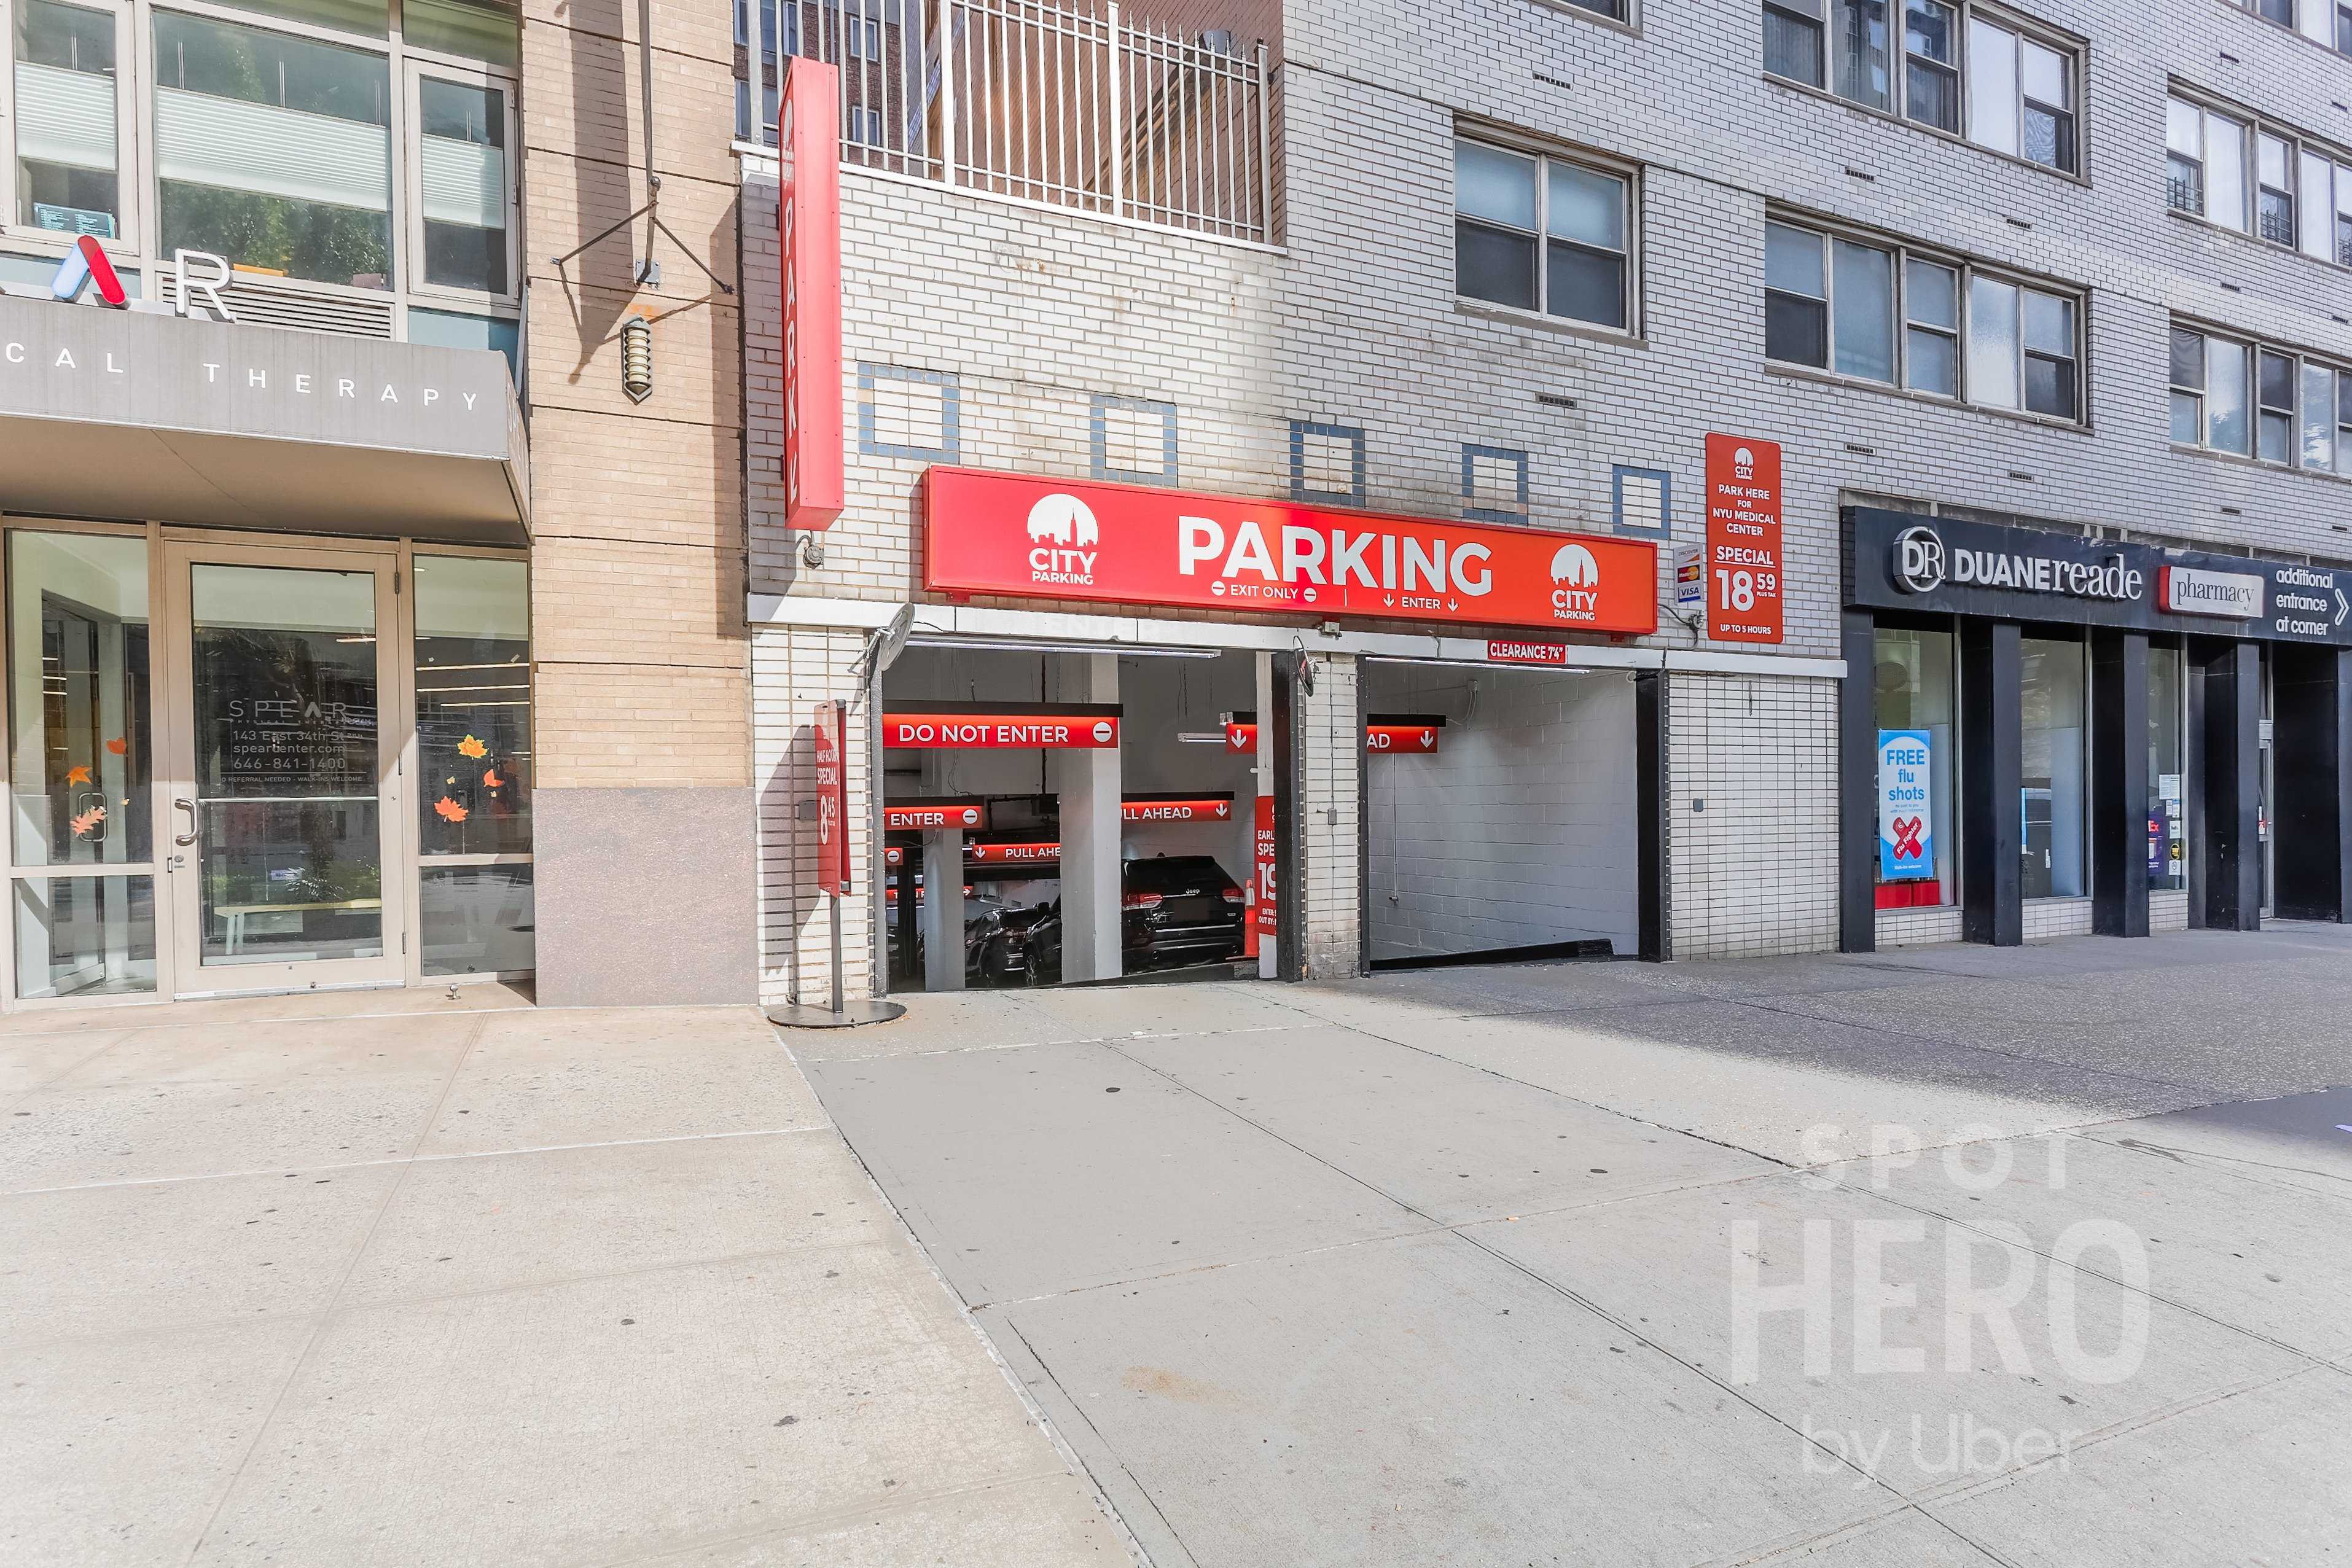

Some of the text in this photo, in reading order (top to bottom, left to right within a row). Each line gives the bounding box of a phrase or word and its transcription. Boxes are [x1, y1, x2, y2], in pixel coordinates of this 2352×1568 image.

[6, 342, 477, 411] CAL THERAPY
[1735, 466, 1753, 475] CITY
[1719, 484, 1770, 500] PARK HERE
[1737, 499, 1752, 509] FOR
[1713, 507, 1776, 524] NYU MEDICAL
[1727, 523, 1764, 536] CENTER
[1029, 547, 1097, 574] CITY
[1178, 515, 1493, 597] PARKING
[1716, 545, 1773, 566] SPECIAL
[1032, 571, 1093, 585] PARKING
[2276, 568, 2333, 589] additional
[1230, 584, 1298, 601] EXIT ONLY
[1681, 587, 1700, 596] VISA
[1716, 569, 1776, 612] 18 59
[2175, 579, 2256, 617] pharmacy
[1401, 596, 1441, 610] ENTER
[1552, 589, 1597, 611] CITY
[2276, 592, 2327, 612] entrance
[1553, 609, 1595, 622] PARKING
[1720, 623, 1730, 632] UP
[1731, 624, 1741, 633] TO
[1748, 625, 1772, 634] HOURS
[2276, 615, 2329, 636] at corner
[1490, 642, 1546, 659] CLEARANCE
[229, 700, 346, 718] SPEAR
[233, 730, 256, 741] 143
[262, 730, 292, 741] East
[296, 730, 326, 741] 34th
[330, 731, 345, 741] St
[899, 724, 1068, 743] DO NOT ENTER
[233, 744, 345, 755] spearcenter.com
[816, 749, 825, 763] HALF
[1886, 749, 1925, 765] FREE
[233, 758, 345, 769] 646-841-1400
[817, 767, 838, 786] SPECIAL
[1898, 768, 1914, 782] flu
[1888, 786, 1924, 801] shots
[821, 795, 828, 845] 8
[828, 796, 835, 818] 45
[891, 813, 944, 826] ENTER
[1142, 806, 1192, 819] AHEAD
[1257, 830, 1275, 841] EARL
[1903, 822, 1918, 844] Fighter
[1006, 848, 1034, 858] PULL
